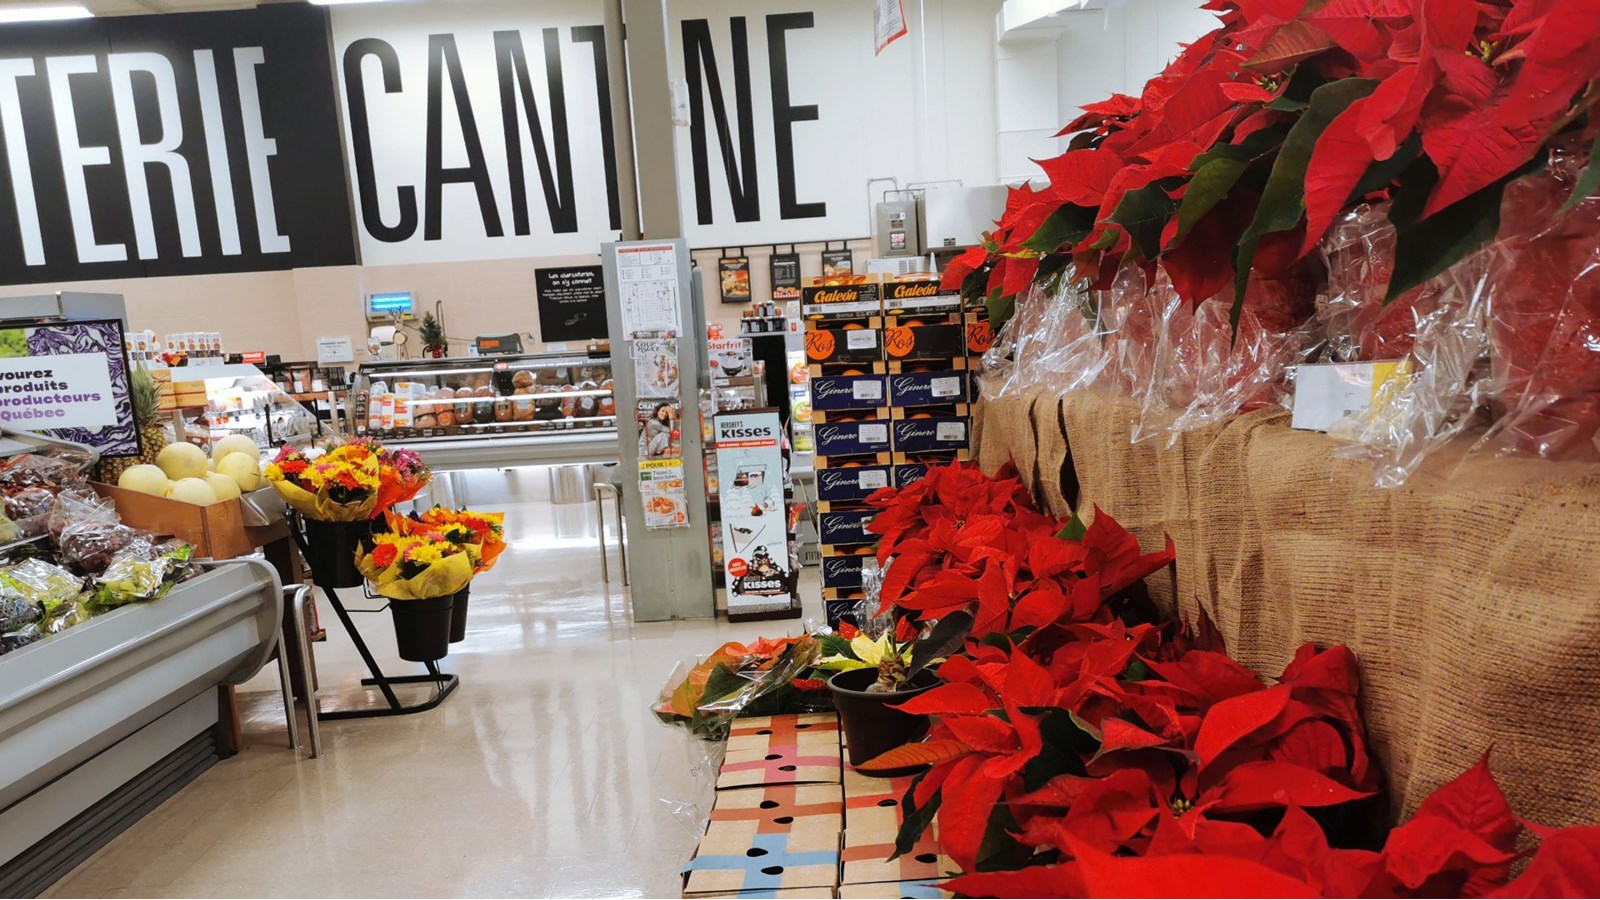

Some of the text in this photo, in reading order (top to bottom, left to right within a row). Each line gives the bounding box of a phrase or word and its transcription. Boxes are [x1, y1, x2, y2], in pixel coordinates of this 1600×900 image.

[342, 11, 826, 243] CANTNE
[0, 46, 291, 266] TERIE
[813, 288, 858, 304] Galeón
[893, 283, 938, 298] Galeón
[806, 330, 835, 352] Ros
[885, 328, 915, 350] Ros
[0, 407, 65, 421] Québec
[818, 426, 857, 446] Ginero
[896, 422, 935, 442] Ginero
